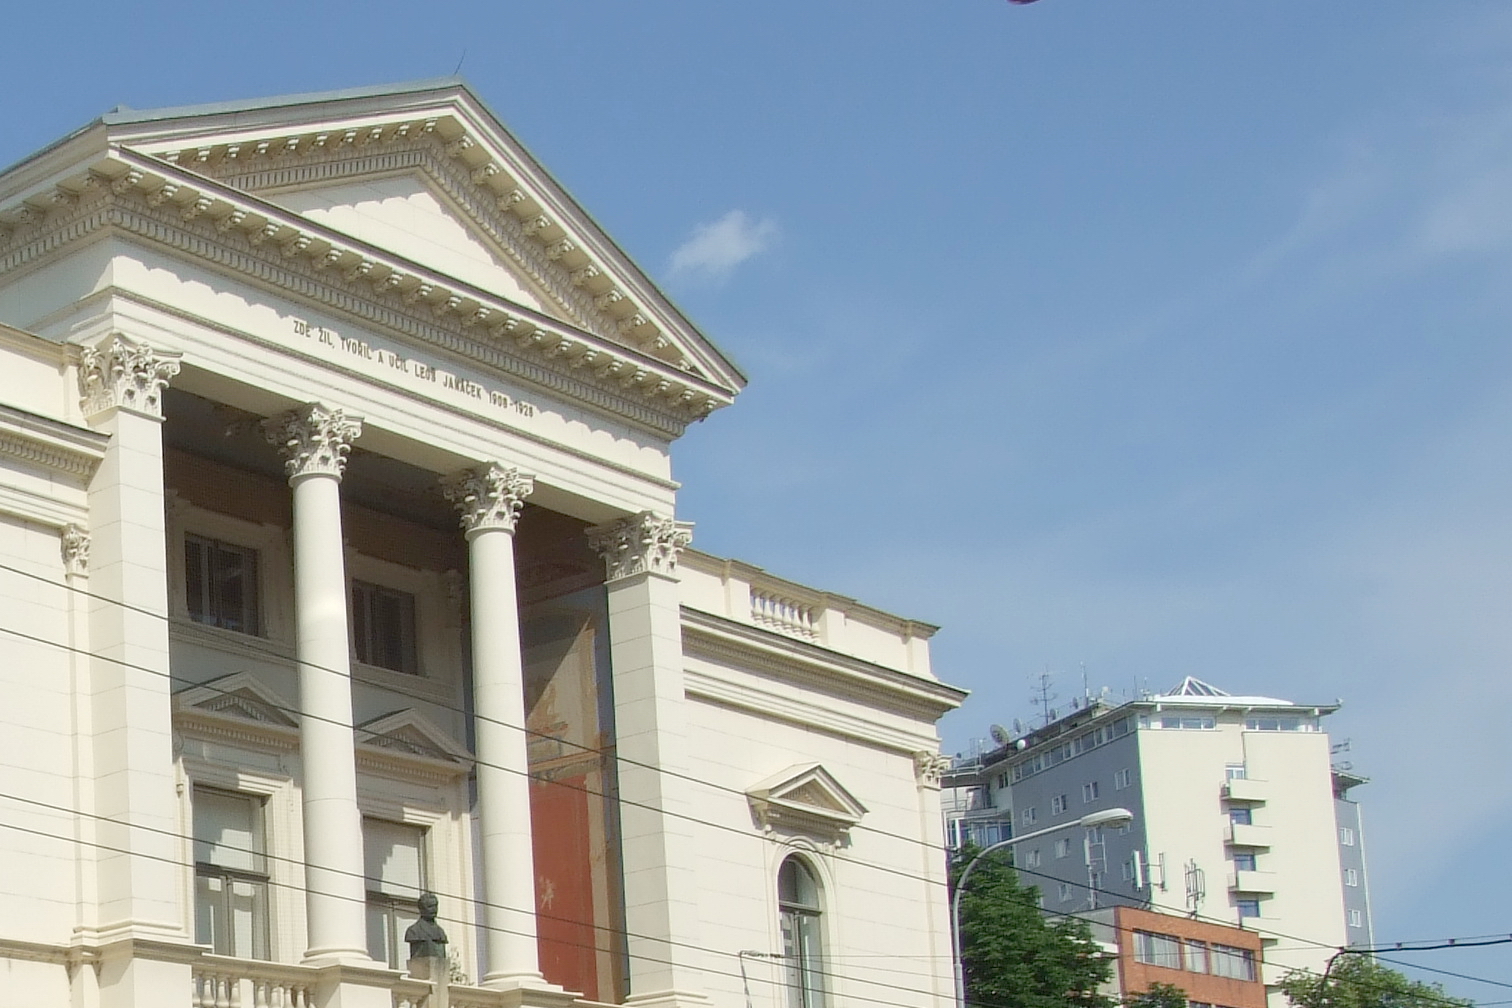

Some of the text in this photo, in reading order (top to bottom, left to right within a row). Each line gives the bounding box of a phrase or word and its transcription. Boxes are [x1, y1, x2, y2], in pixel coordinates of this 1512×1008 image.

[293, 320, 311, 338] ZDE
[340, 336, 372, 360] TVOŘIL
[377, 351, 384, 364] A
[388, 353, 409, 374] UČIL
[414, 363, 436, 382] LEOŠ
[442, 374, 482, 400] JANÁČEK
